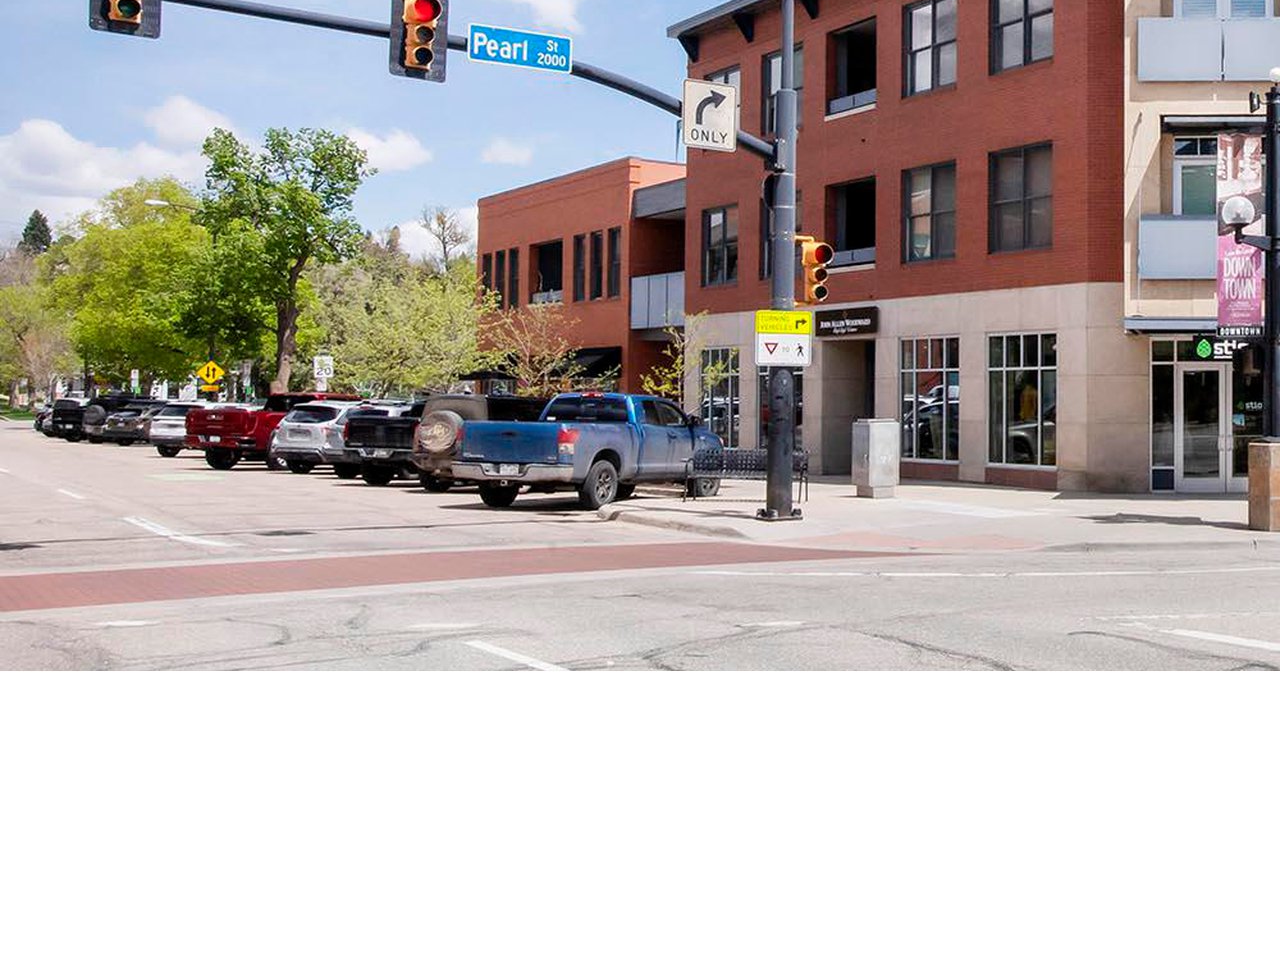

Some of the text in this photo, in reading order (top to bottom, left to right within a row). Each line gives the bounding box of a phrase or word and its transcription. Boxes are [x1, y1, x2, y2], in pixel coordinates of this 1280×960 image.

[473, 32, 559, 61] Pearl St
[537, 53, 567, 67] 2000
[690, 128, 728, 144] ONLY
[1223, 257, 1256, 278] DOWN
[1223, 278, 1257, 300] TOWN
[1220, 327, 1261, 336] DOWNTOWN
[316, 367, 332, 376] 20
[1245, 401, 1263, 410] stio
